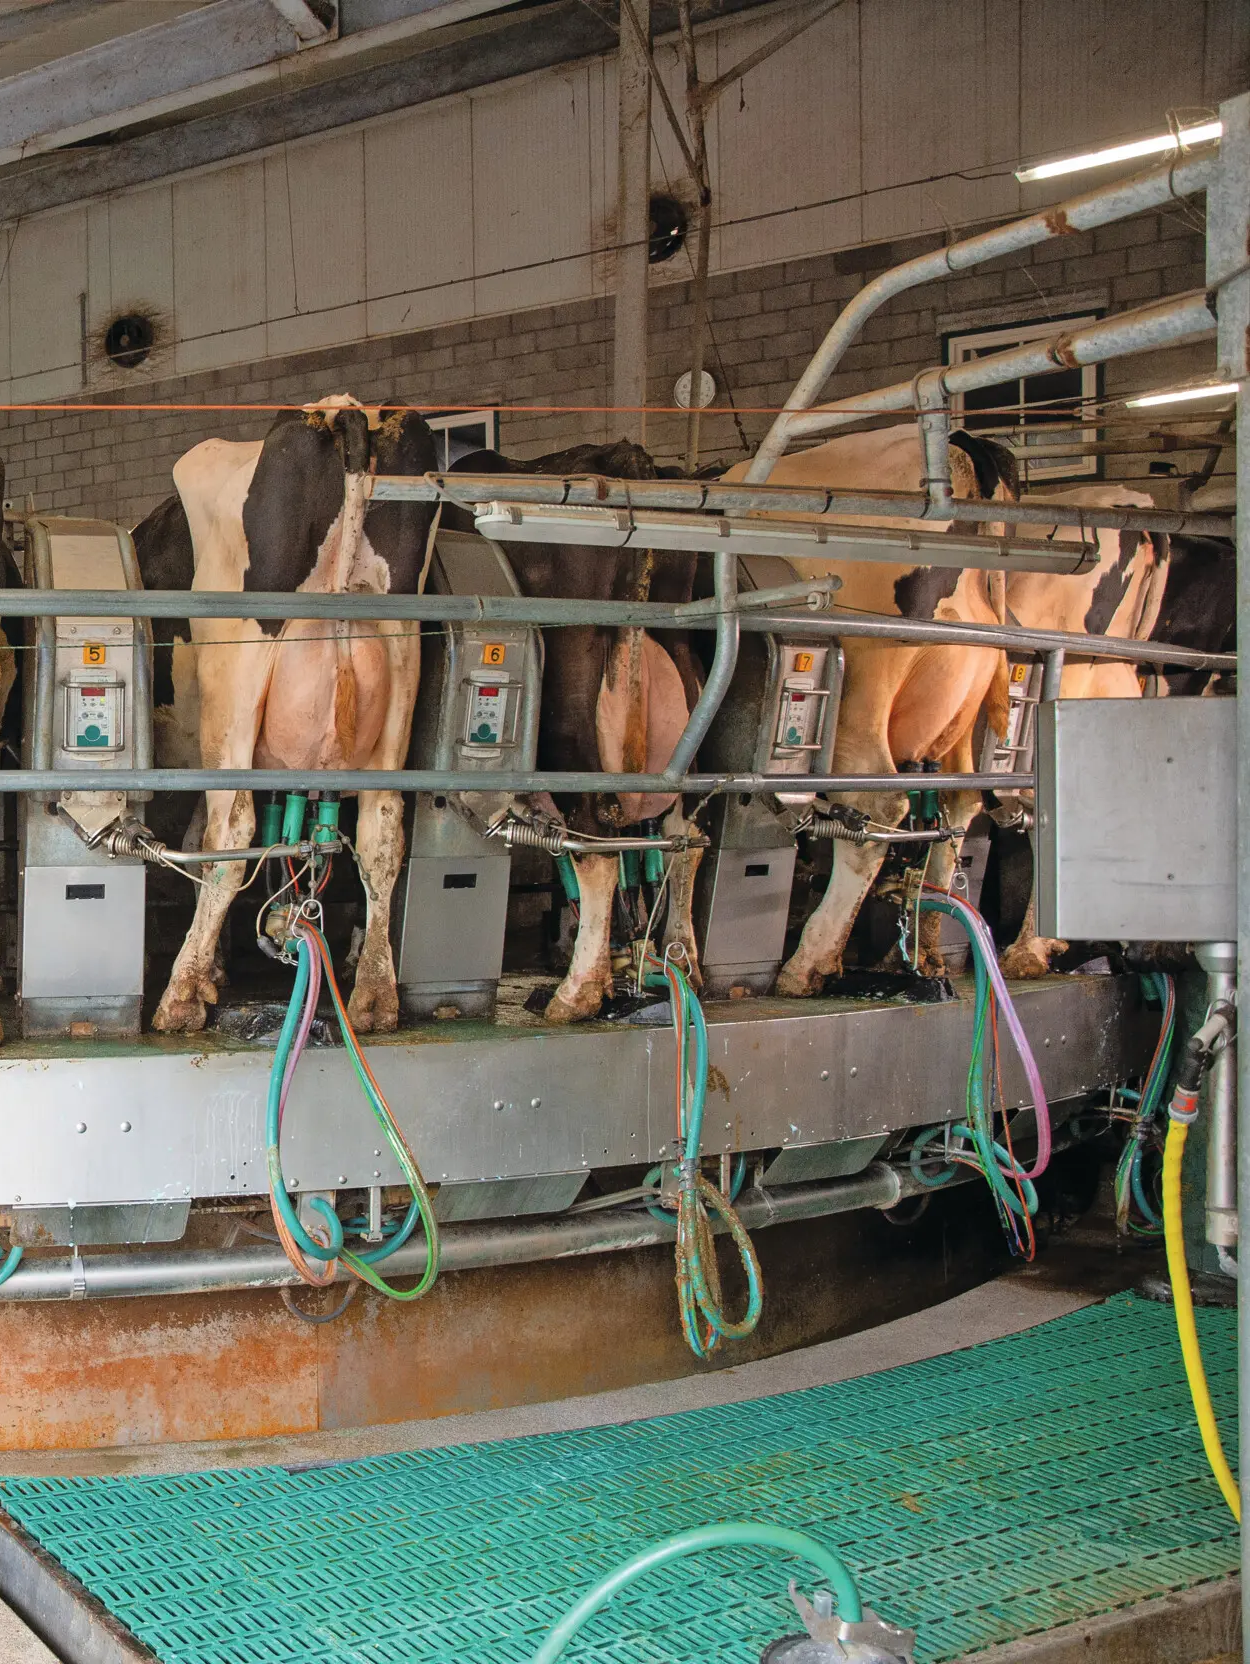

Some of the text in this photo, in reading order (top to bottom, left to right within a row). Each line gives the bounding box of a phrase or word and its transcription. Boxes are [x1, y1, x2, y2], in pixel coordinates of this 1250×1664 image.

[89, 646, 100, 661] 5
[491, 648, 500, 662] 6
[803, 656, 811, 669] 7
